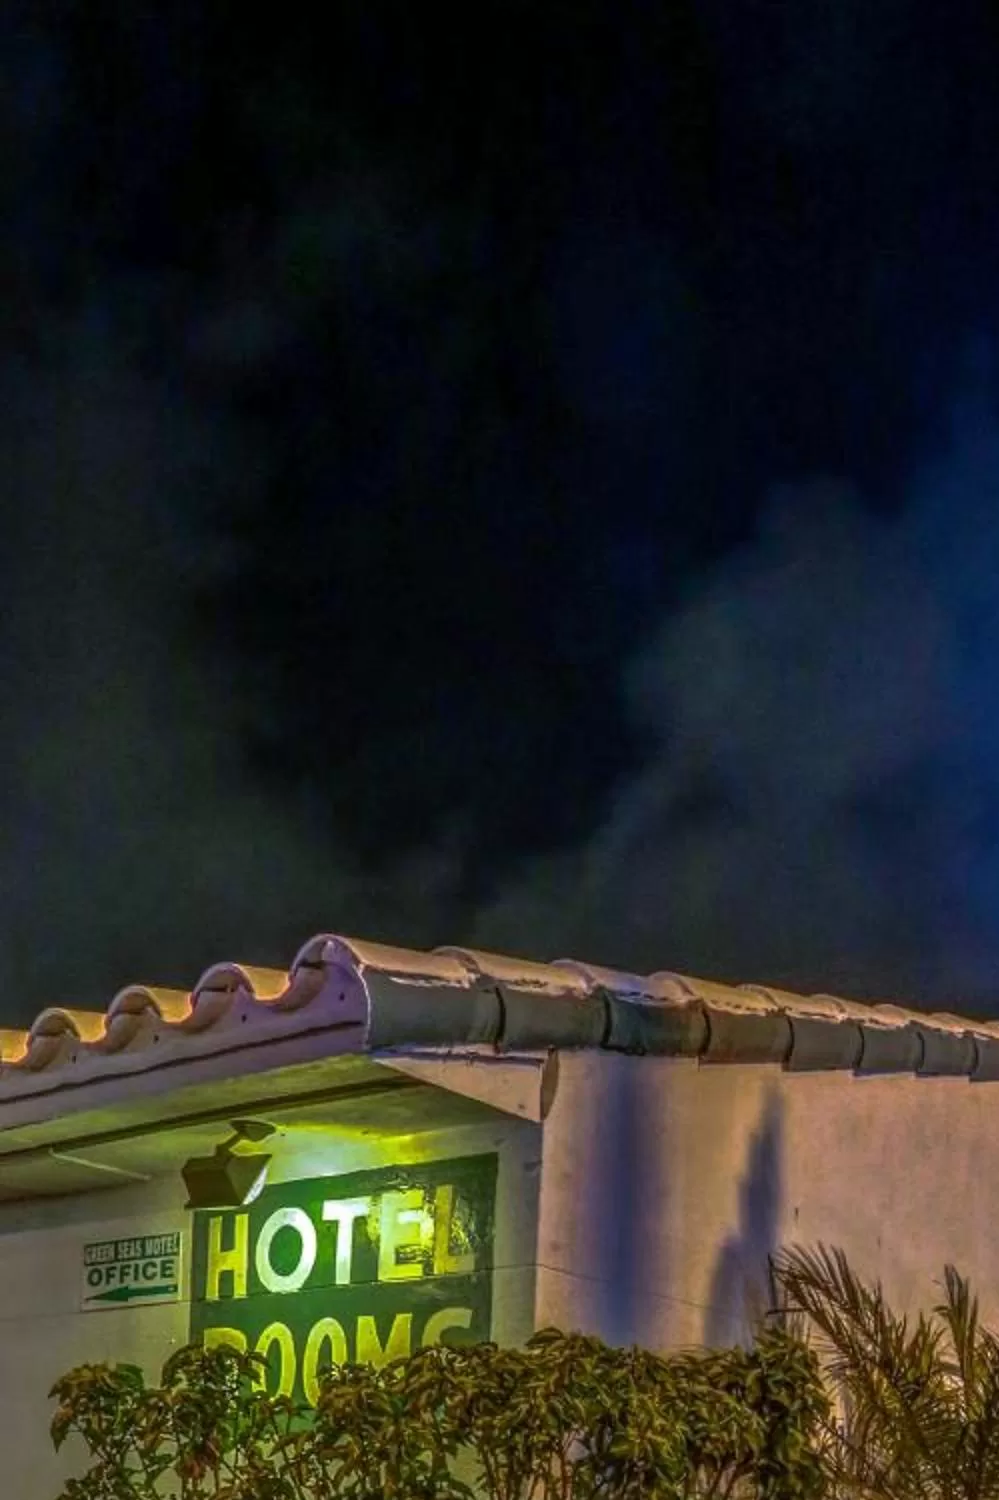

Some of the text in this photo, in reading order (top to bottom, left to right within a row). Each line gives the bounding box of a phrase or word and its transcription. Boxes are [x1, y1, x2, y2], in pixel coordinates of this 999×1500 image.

[87, 1260, 175, 1287] OFFICE
[205, 1184, 475, 1300] HOTEL
[204, 1307, 473, 1408] OOM
